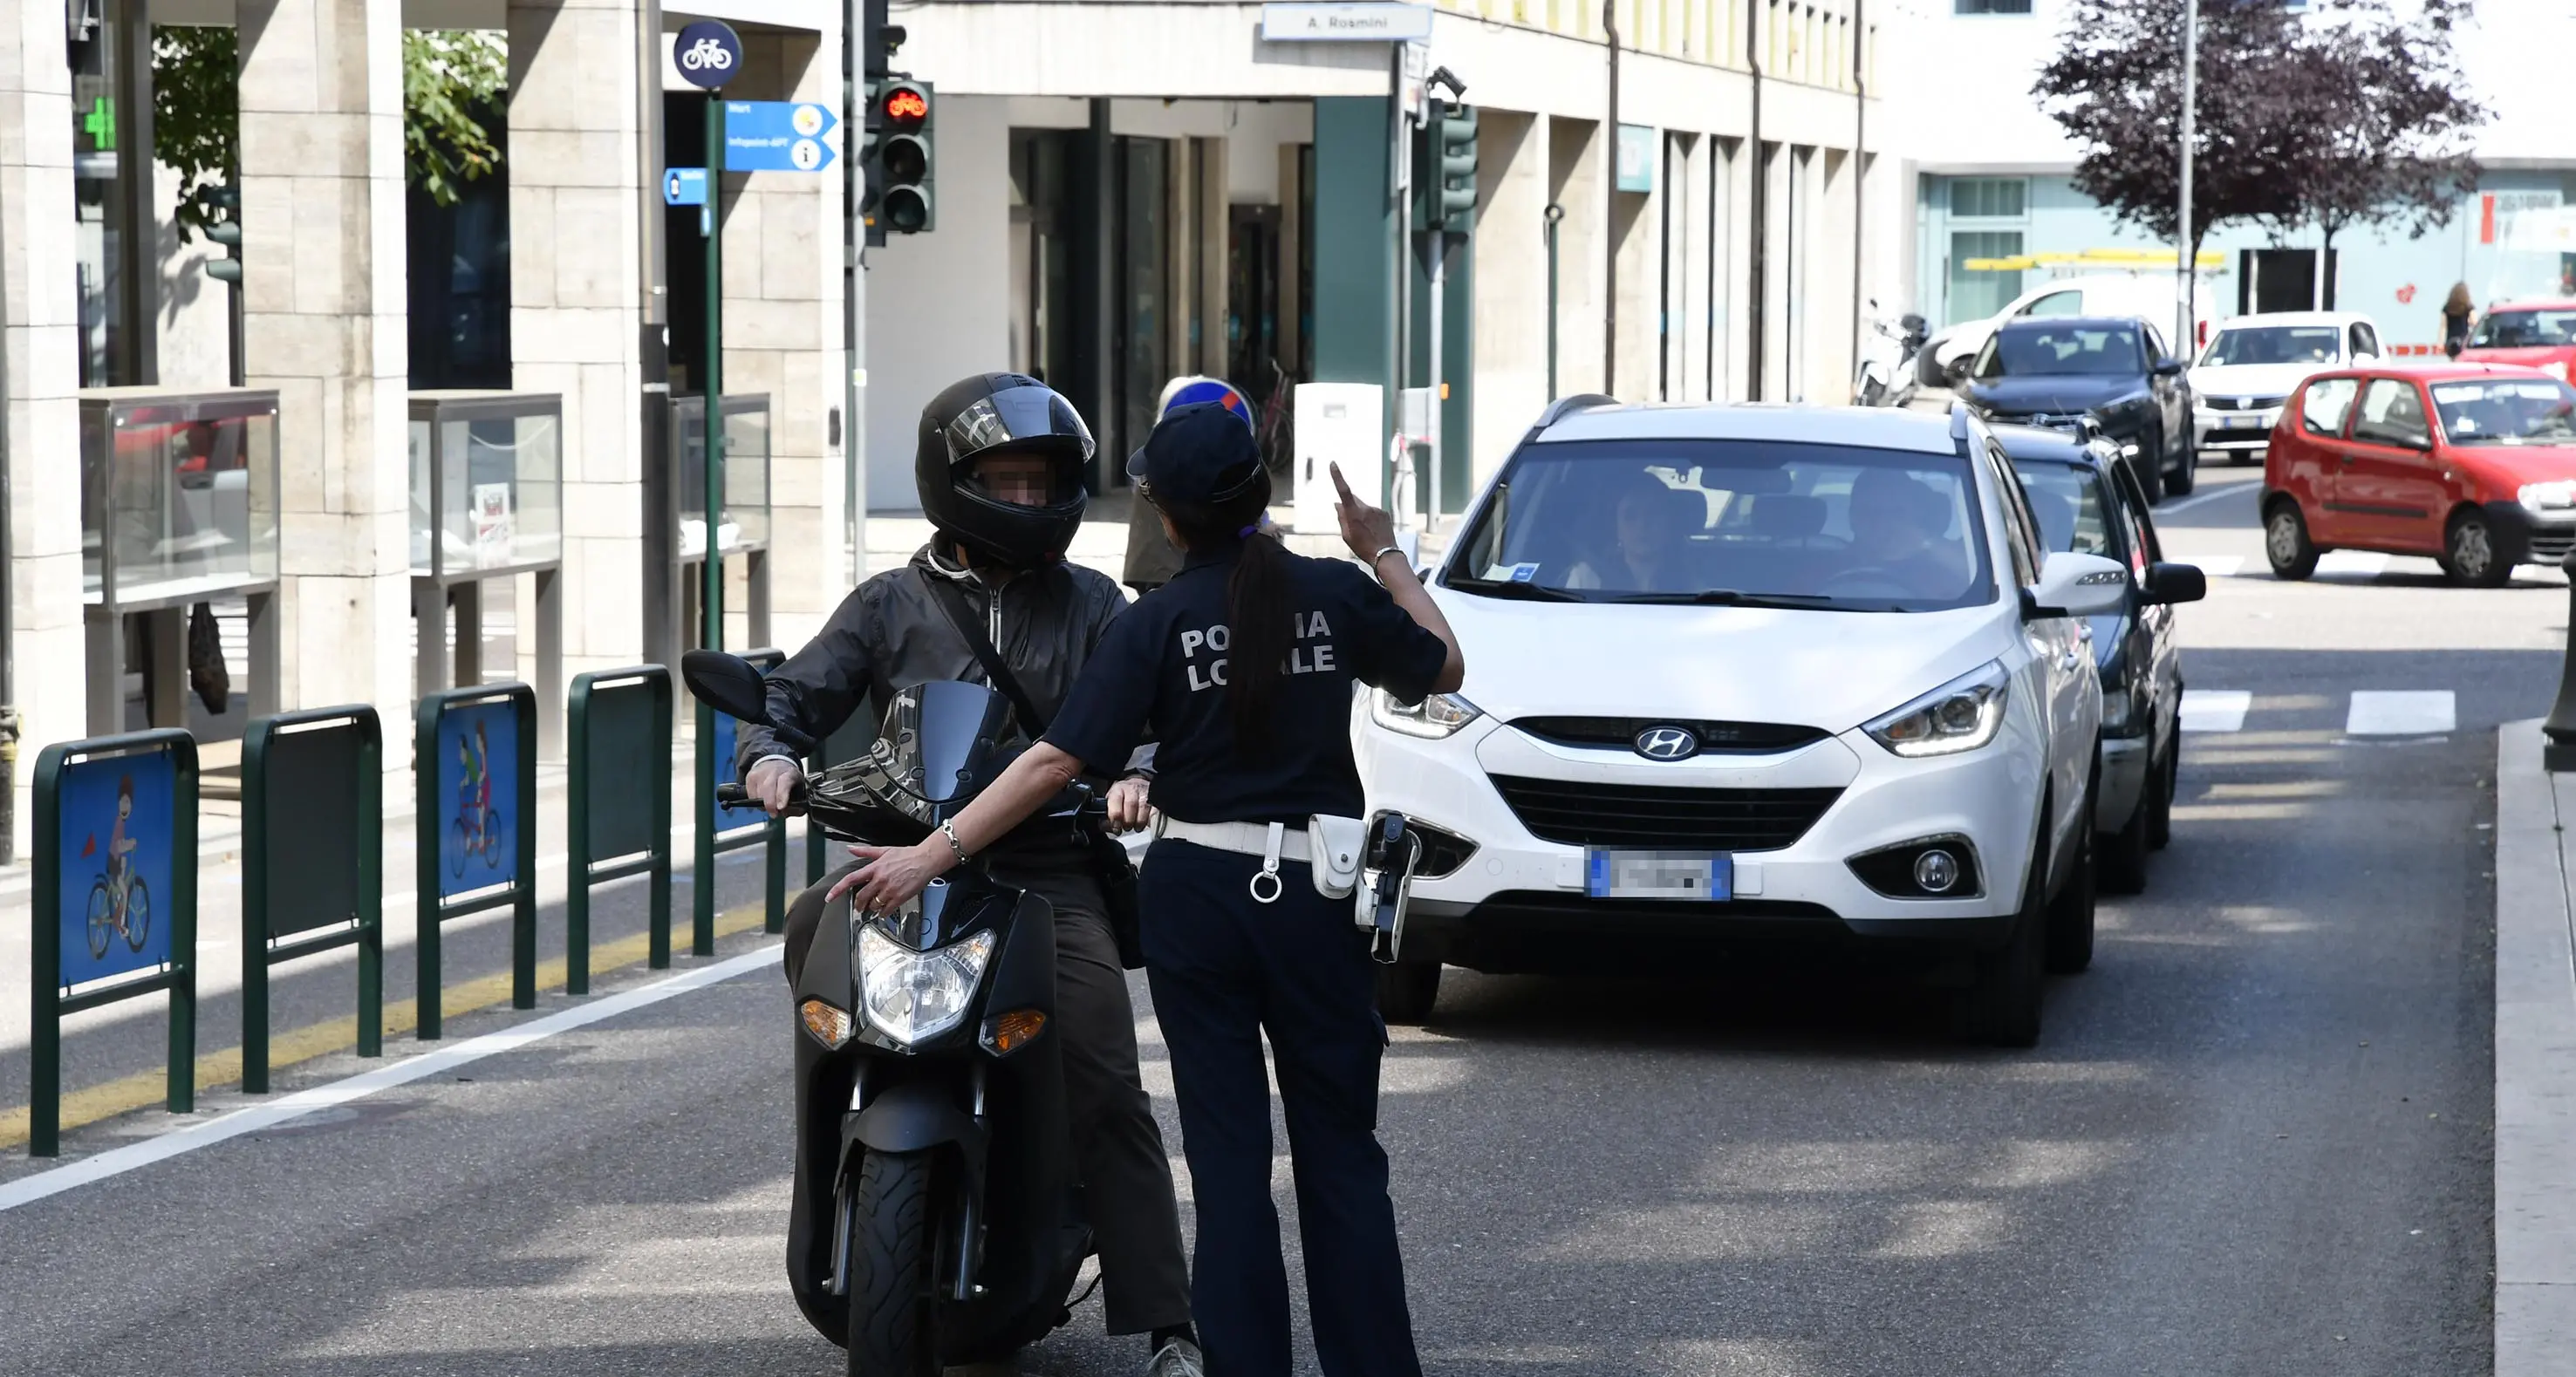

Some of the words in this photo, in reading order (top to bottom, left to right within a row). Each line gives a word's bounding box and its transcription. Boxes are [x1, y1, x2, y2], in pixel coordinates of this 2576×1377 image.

[1329, 17, 1388, 30] Rosmini
[1180, 610, 1331, 658] POIA
[1187, 644, 1336, 692] LOLE
